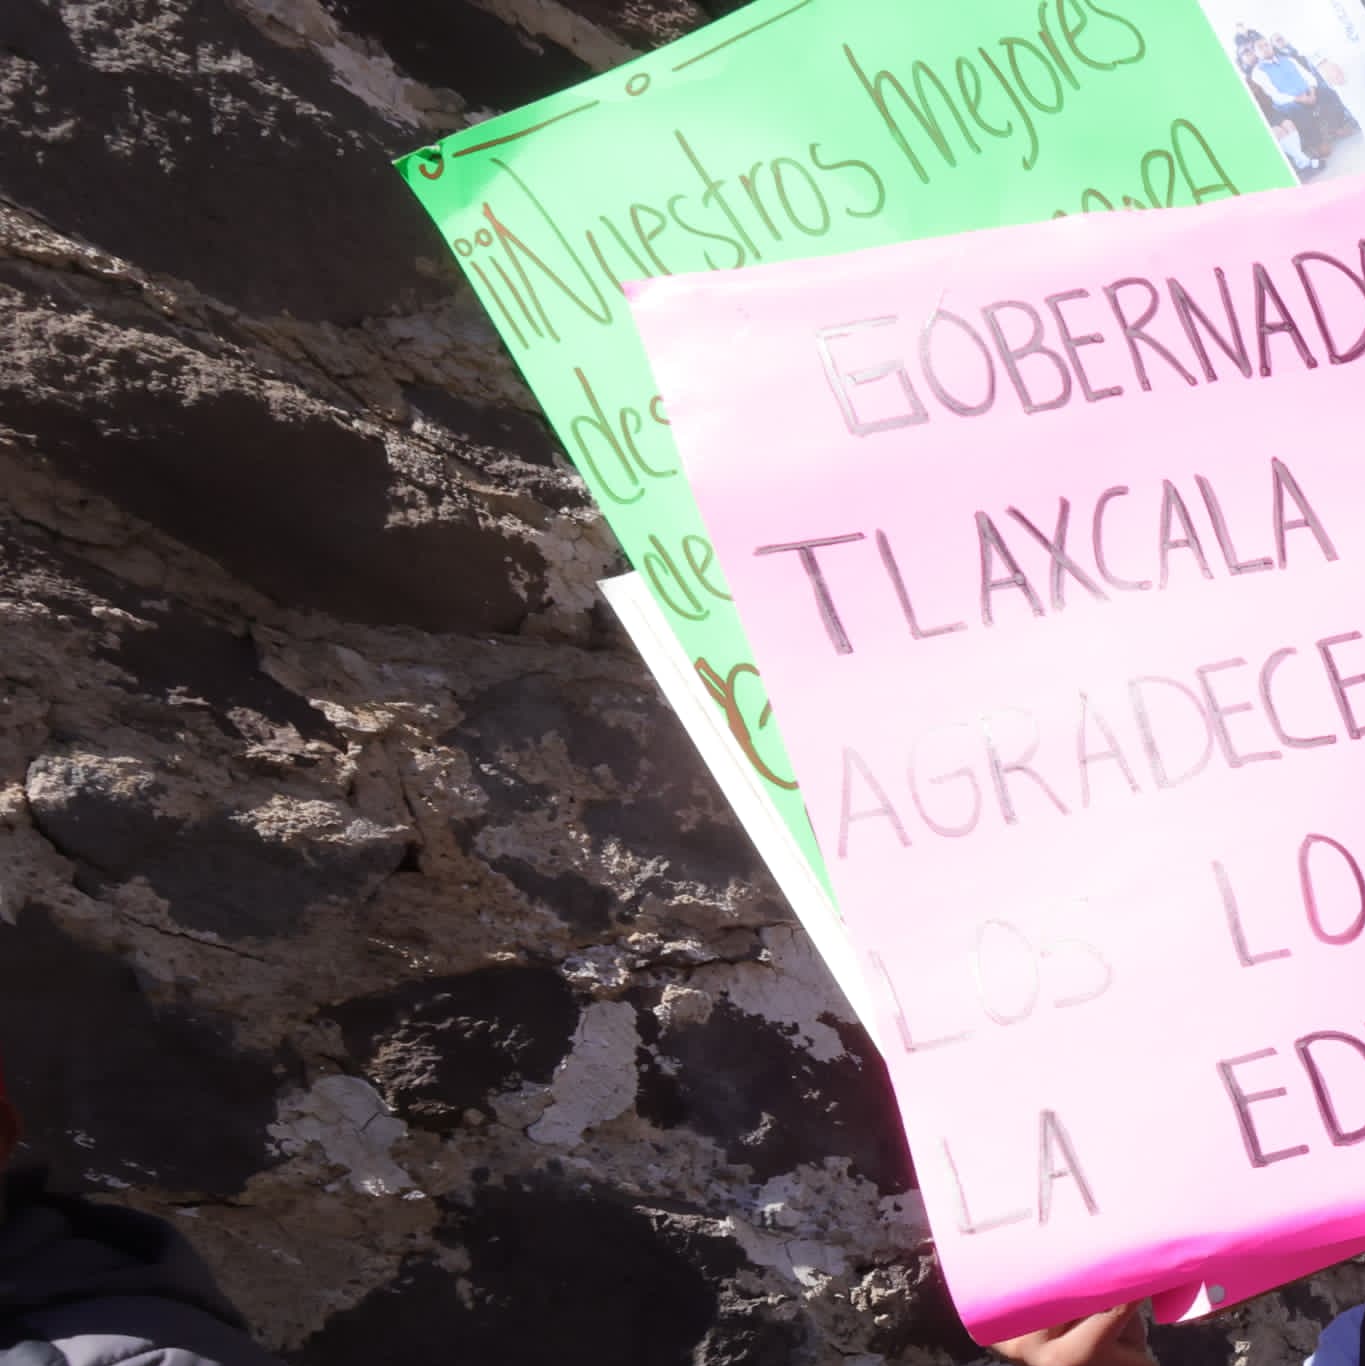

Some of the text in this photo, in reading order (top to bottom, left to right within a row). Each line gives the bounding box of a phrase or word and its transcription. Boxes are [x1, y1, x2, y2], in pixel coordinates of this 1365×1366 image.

[753, 456, 1339, 653] TLAXCALA
[868, 897, 1113, 1053] LOS
[940, 1108, 1099, 1235] LA
